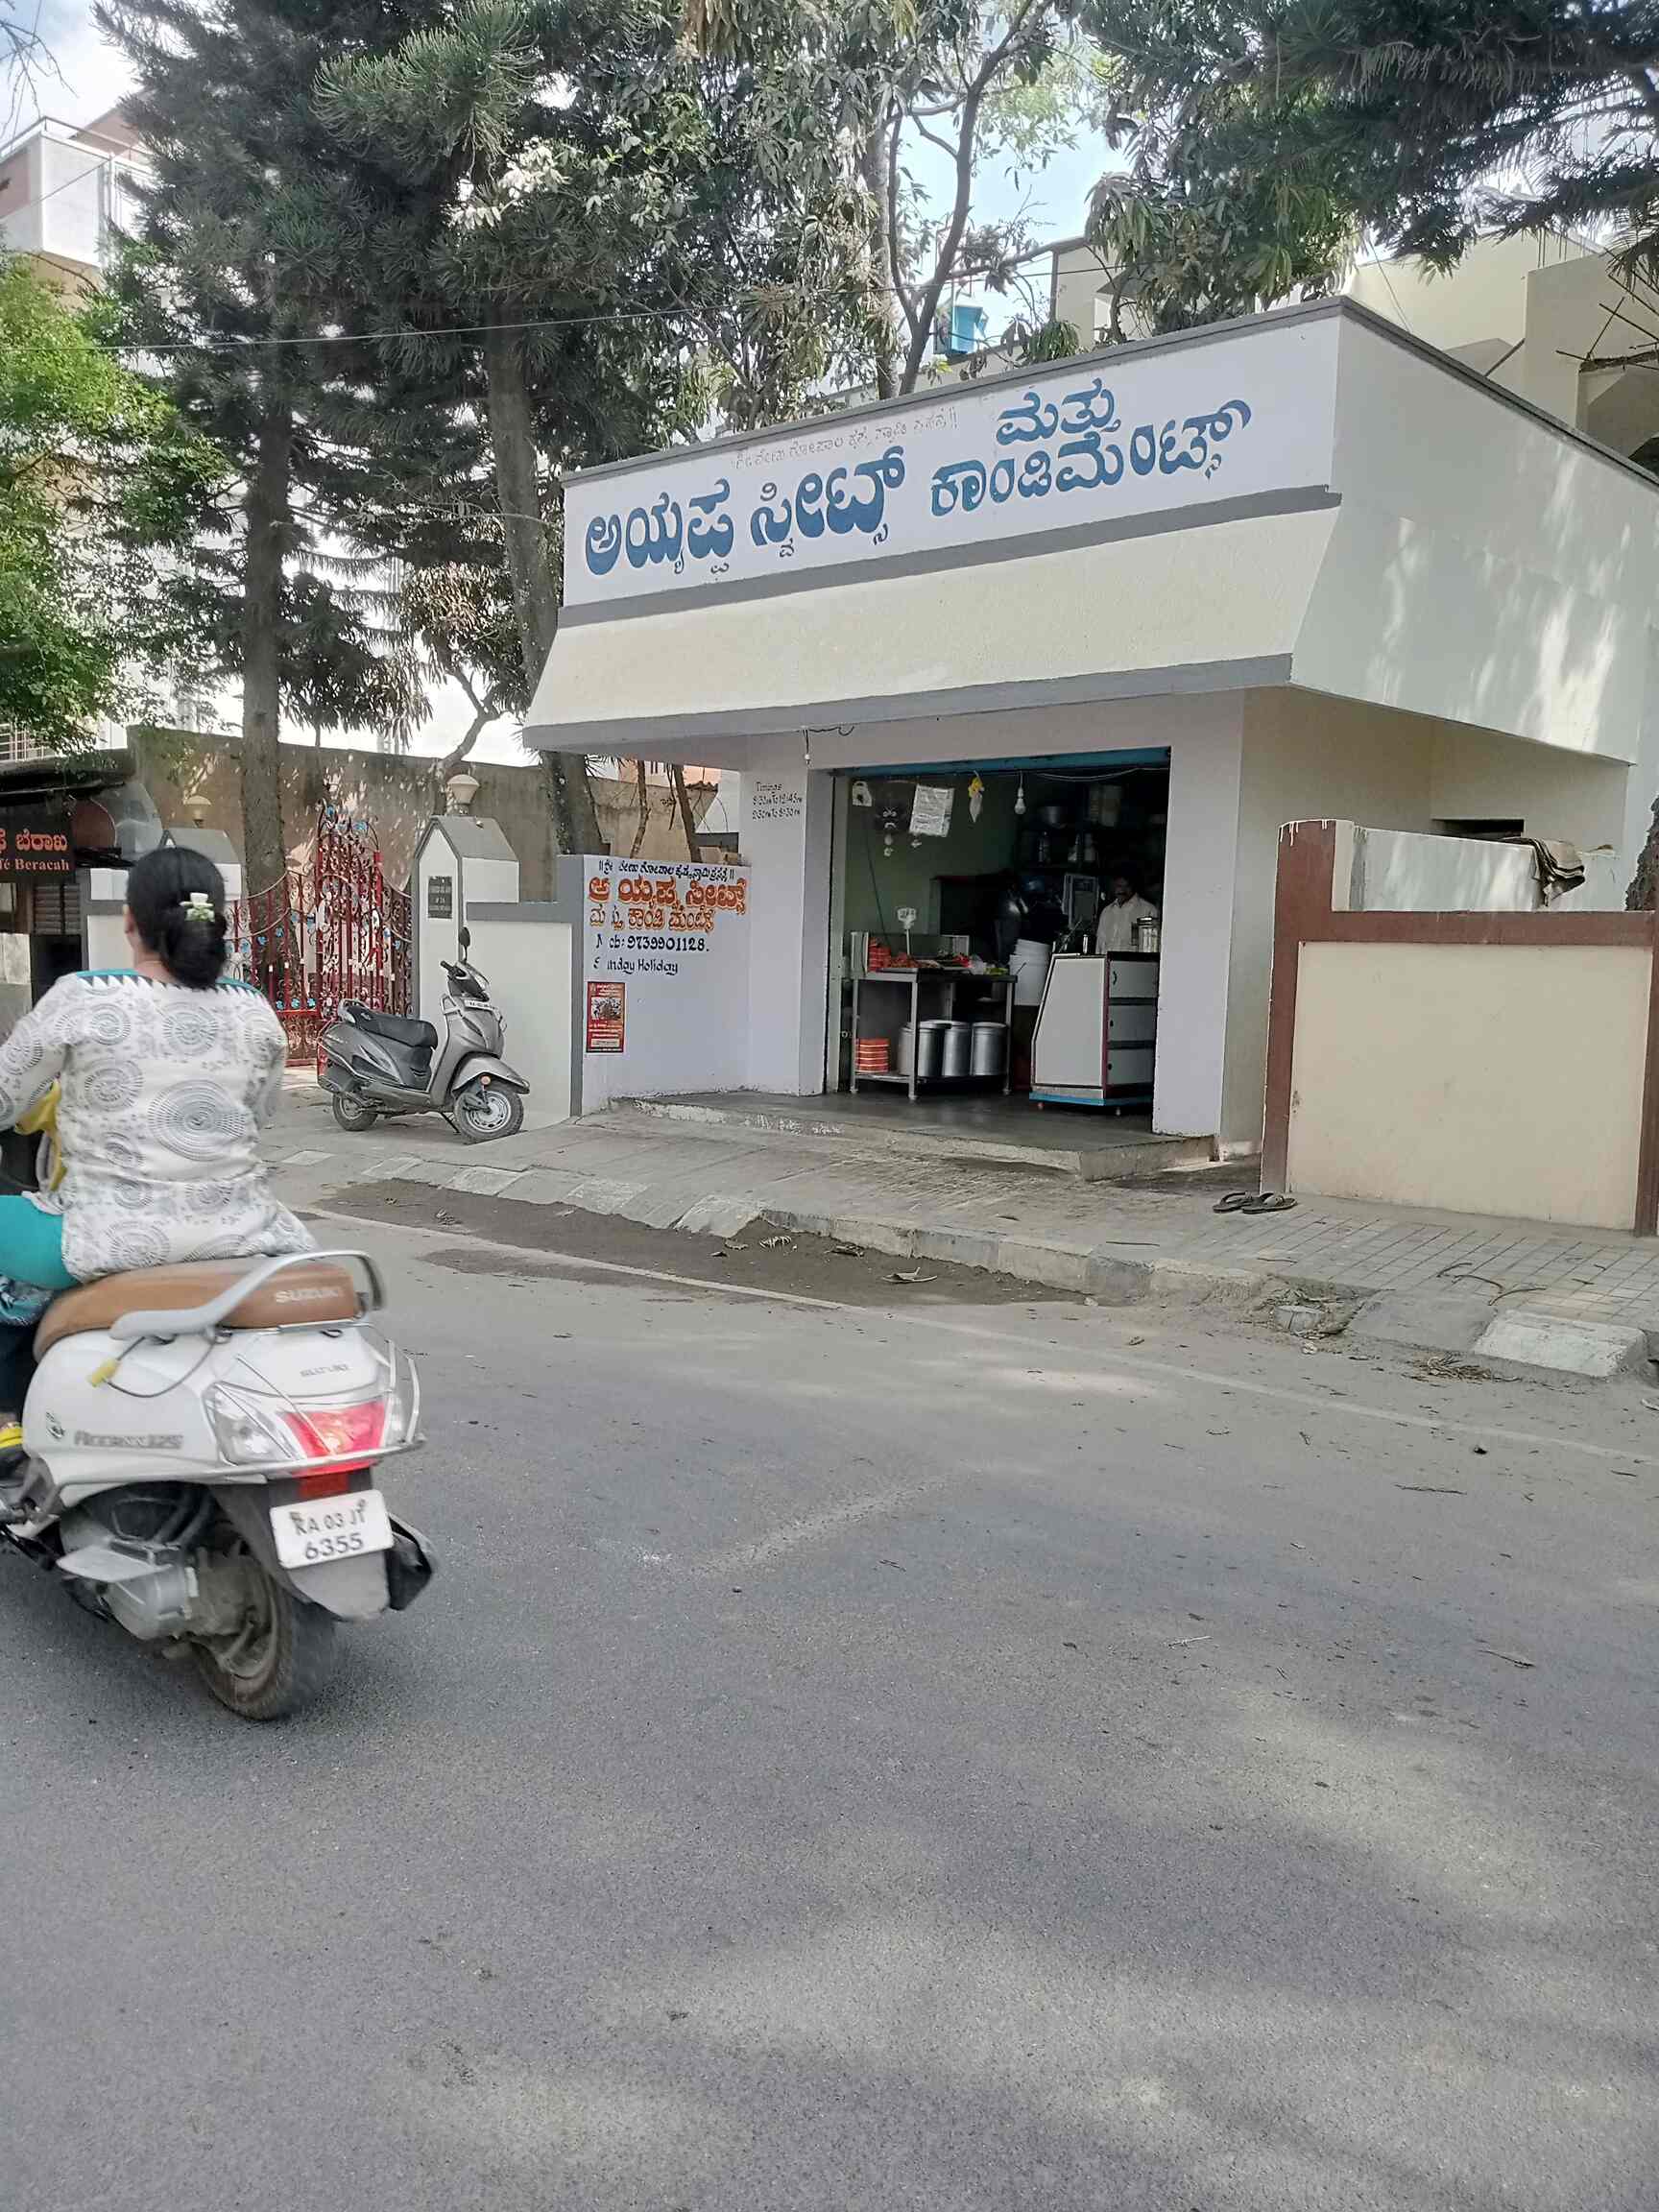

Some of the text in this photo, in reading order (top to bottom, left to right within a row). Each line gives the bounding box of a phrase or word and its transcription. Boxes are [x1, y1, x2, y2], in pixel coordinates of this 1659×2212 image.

[996, 377, 1121, 445] ಮತ್ತು
[585, 399, 1252, 574] ಅಯ್ಯಪ್ಪ ಸ್ವೀಟ್ಸ್ ಕಾಂಡಿಮೆಂಟ್ಸ್
[15, 858, 70, 871] Beracah
[637, 958, 678, 975] Holiday
[305, 1532, 363, 1560] 6355
